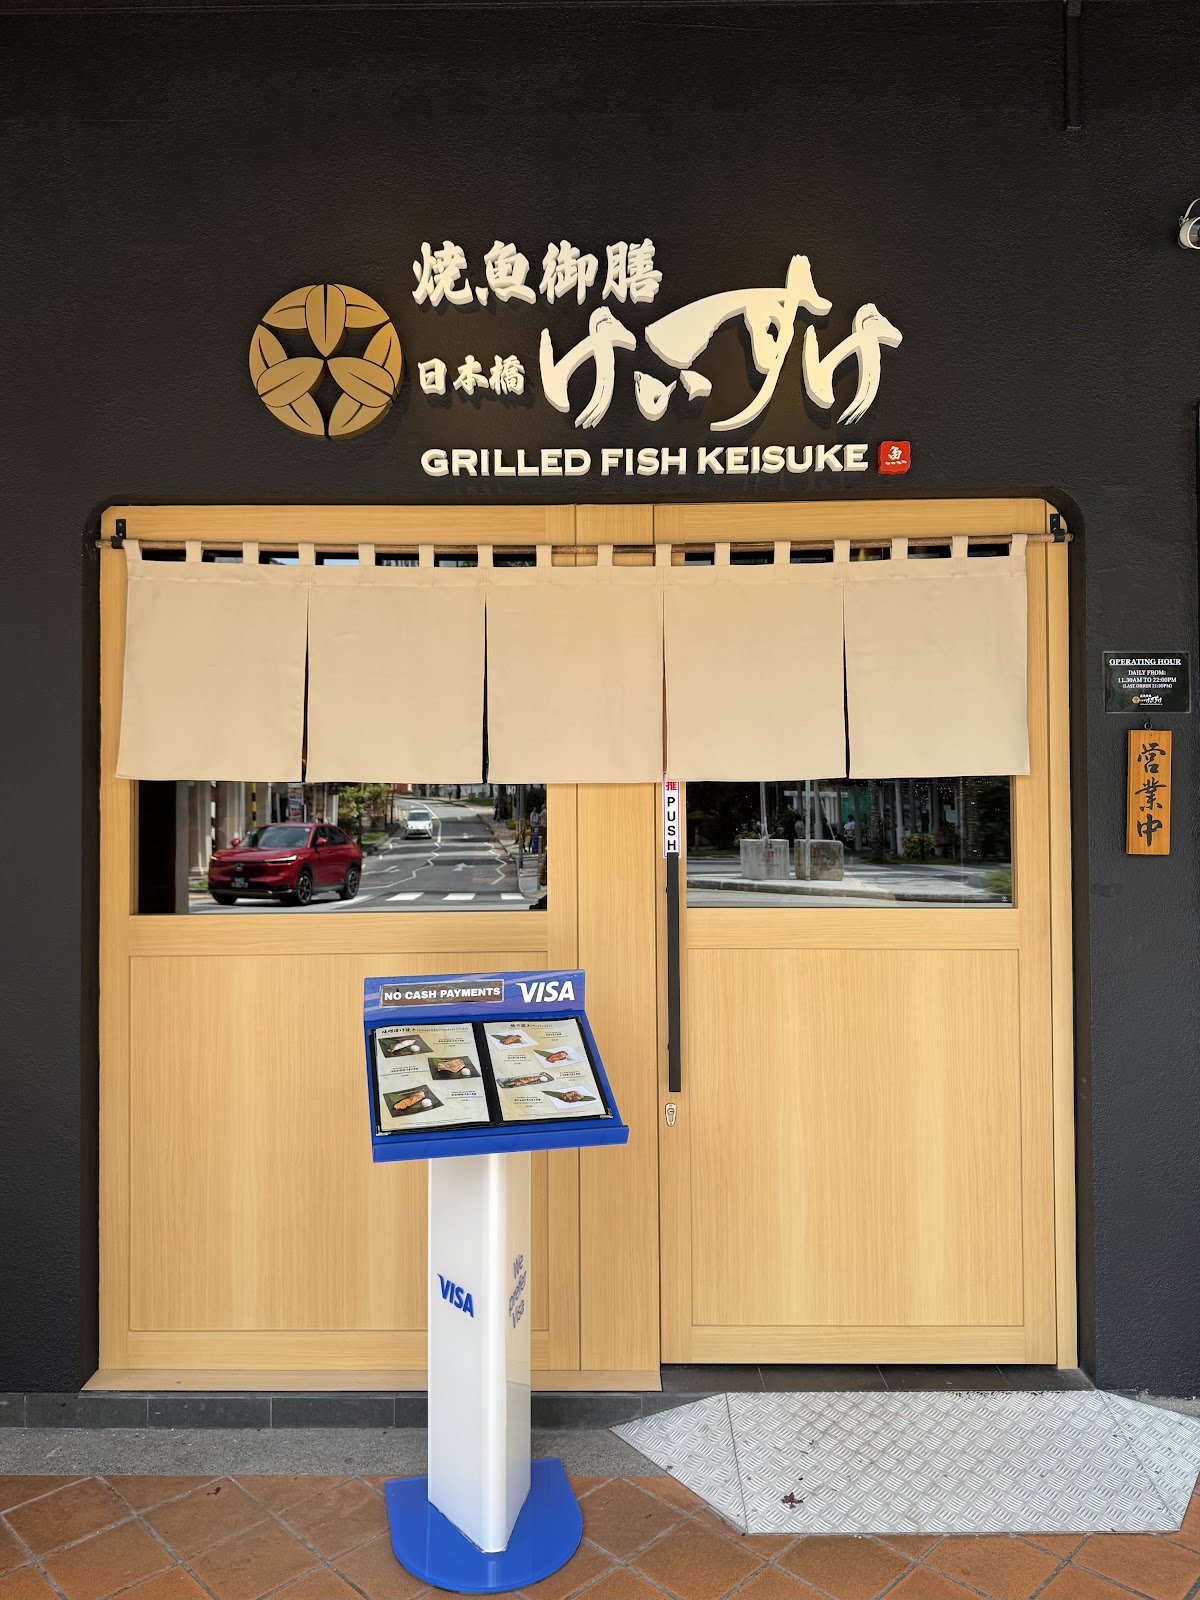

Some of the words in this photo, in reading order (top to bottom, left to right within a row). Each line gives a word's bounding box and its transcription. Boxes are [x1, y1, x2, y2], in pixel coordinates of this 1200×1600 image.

[412, 238, 663, 306] 焼魚御膳
[540, 254, 903, 431] けいすけ
[418, 355, 525, 395] 日本橋
[421, 448, 592, 477] GRILLED
[601, 447, 687, 476] FISH
[697, 443, 869, 475] KEISUKE
[1135, 742, 1167, 847] 営業中
[667, 796, 676, 850] PUSH
[384, 992, 401, 1001] NO
[405, 990, 436, 1000] CASH
[440, 987, 501, 999] PAYMENTS
[516, 980, 575, 1003] VISA
[437, 1273, 474, 1318] VISA
